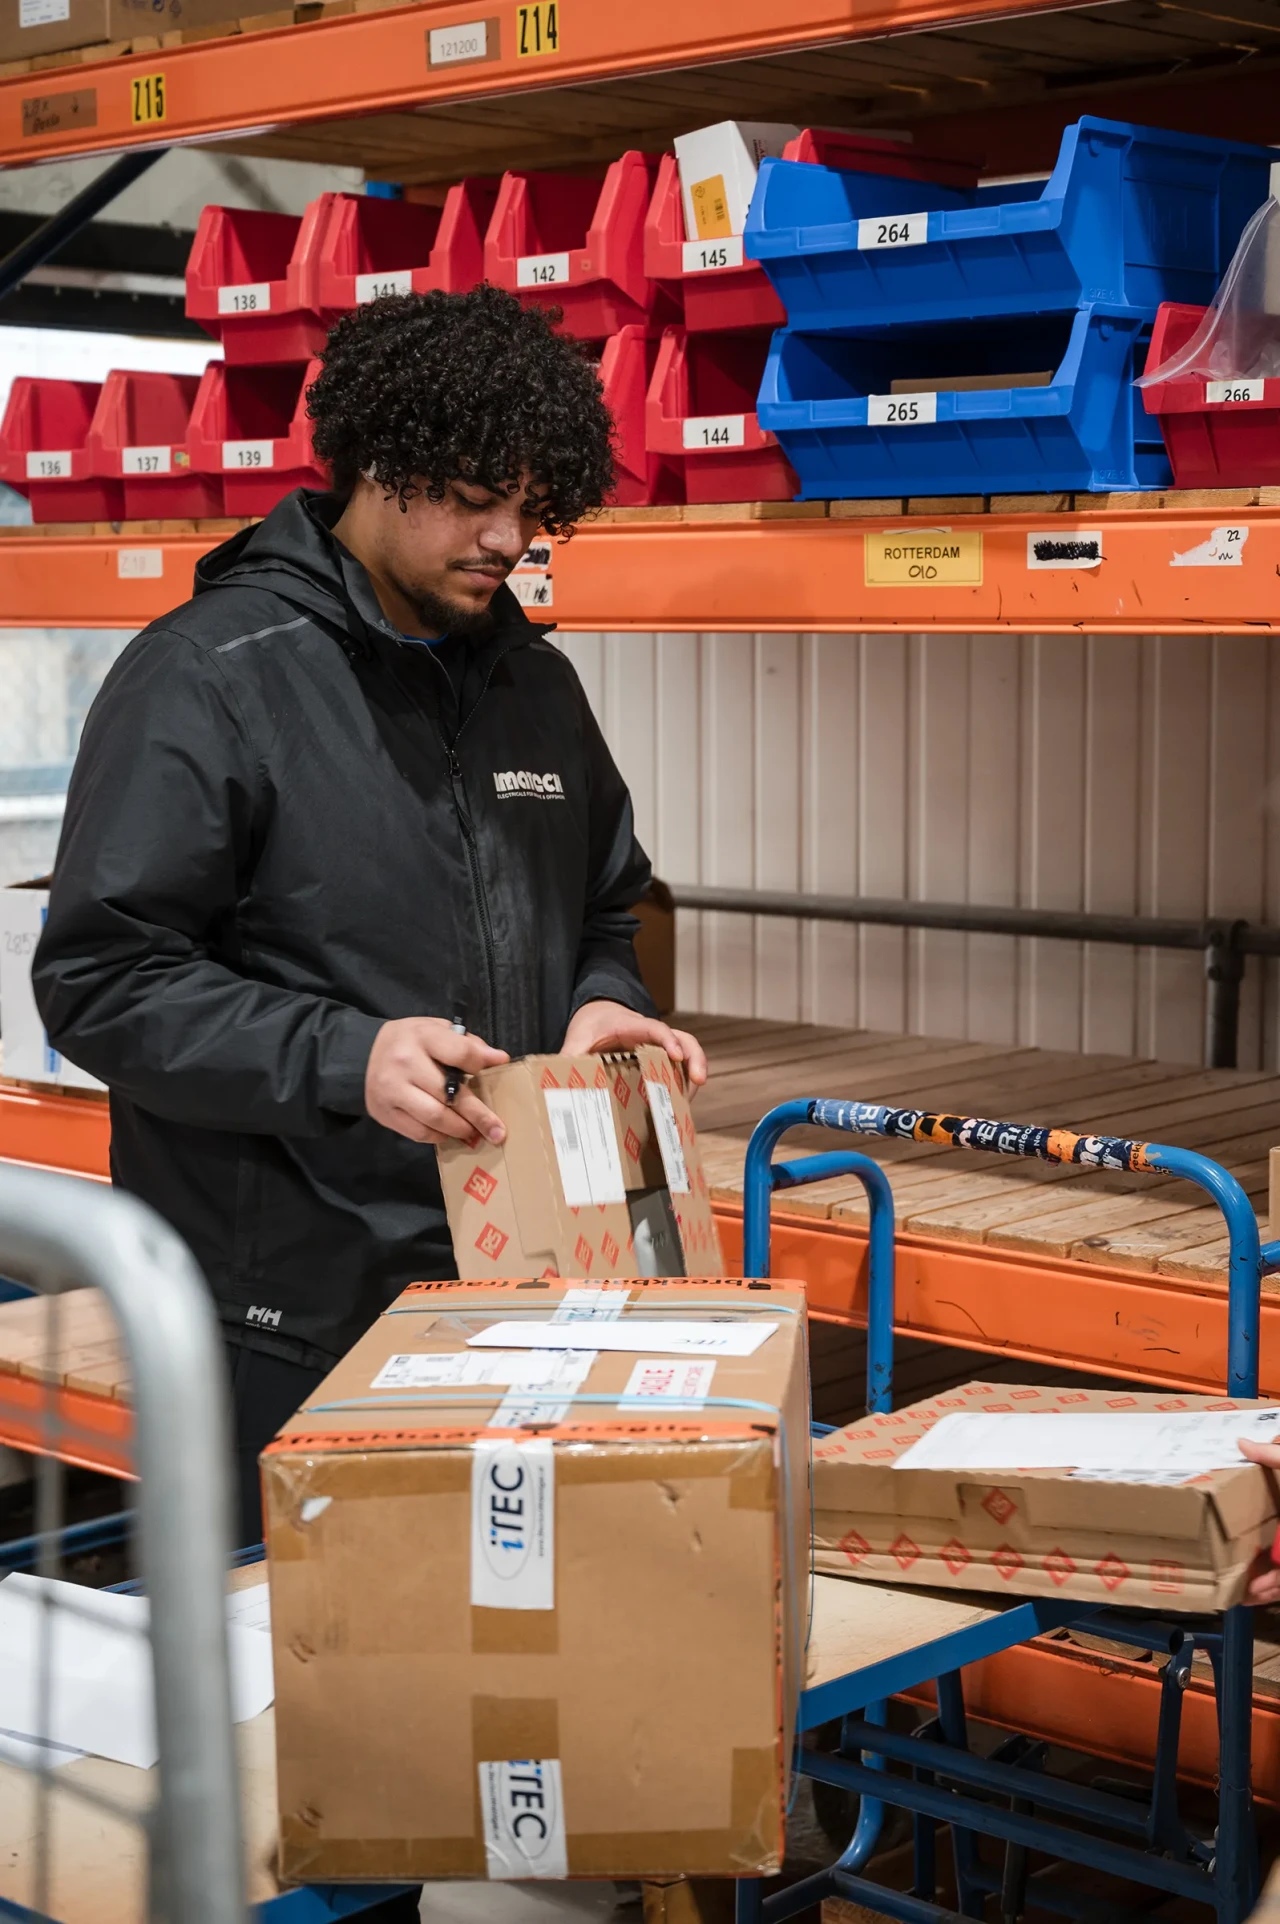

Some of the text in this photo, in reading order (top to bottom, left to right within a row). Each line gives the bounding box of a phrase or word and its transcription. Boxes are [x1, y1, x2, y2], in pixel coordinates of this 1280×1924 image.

[519, 3, 558, 54] Z14
[440, 38, 478, 57] 121200
[134, 76, 164, 122] Z15
[877, 223, 910, 244] 264
[700, 248, 728, 268] 145
[532, 265, 556, 284] 142
[372, 282, 396, 298] 141
[233, 294, 257, 311] 138
[1224, 388, 1251, 402] 266
[886, 402, 919, 422] 265
[702, 427, 730, 445] 144
[40, 461, 61, 475] 136
[137, 456, 159, 471] 137
[238, 451, 261, 467] 139
[1227, 529, 1241, 542] 22
[884, 546, 960, 560] ROTTERDAM
[246, 1305, 283, 1327] HH
[491, 1464, 524, 1550] iTEC
